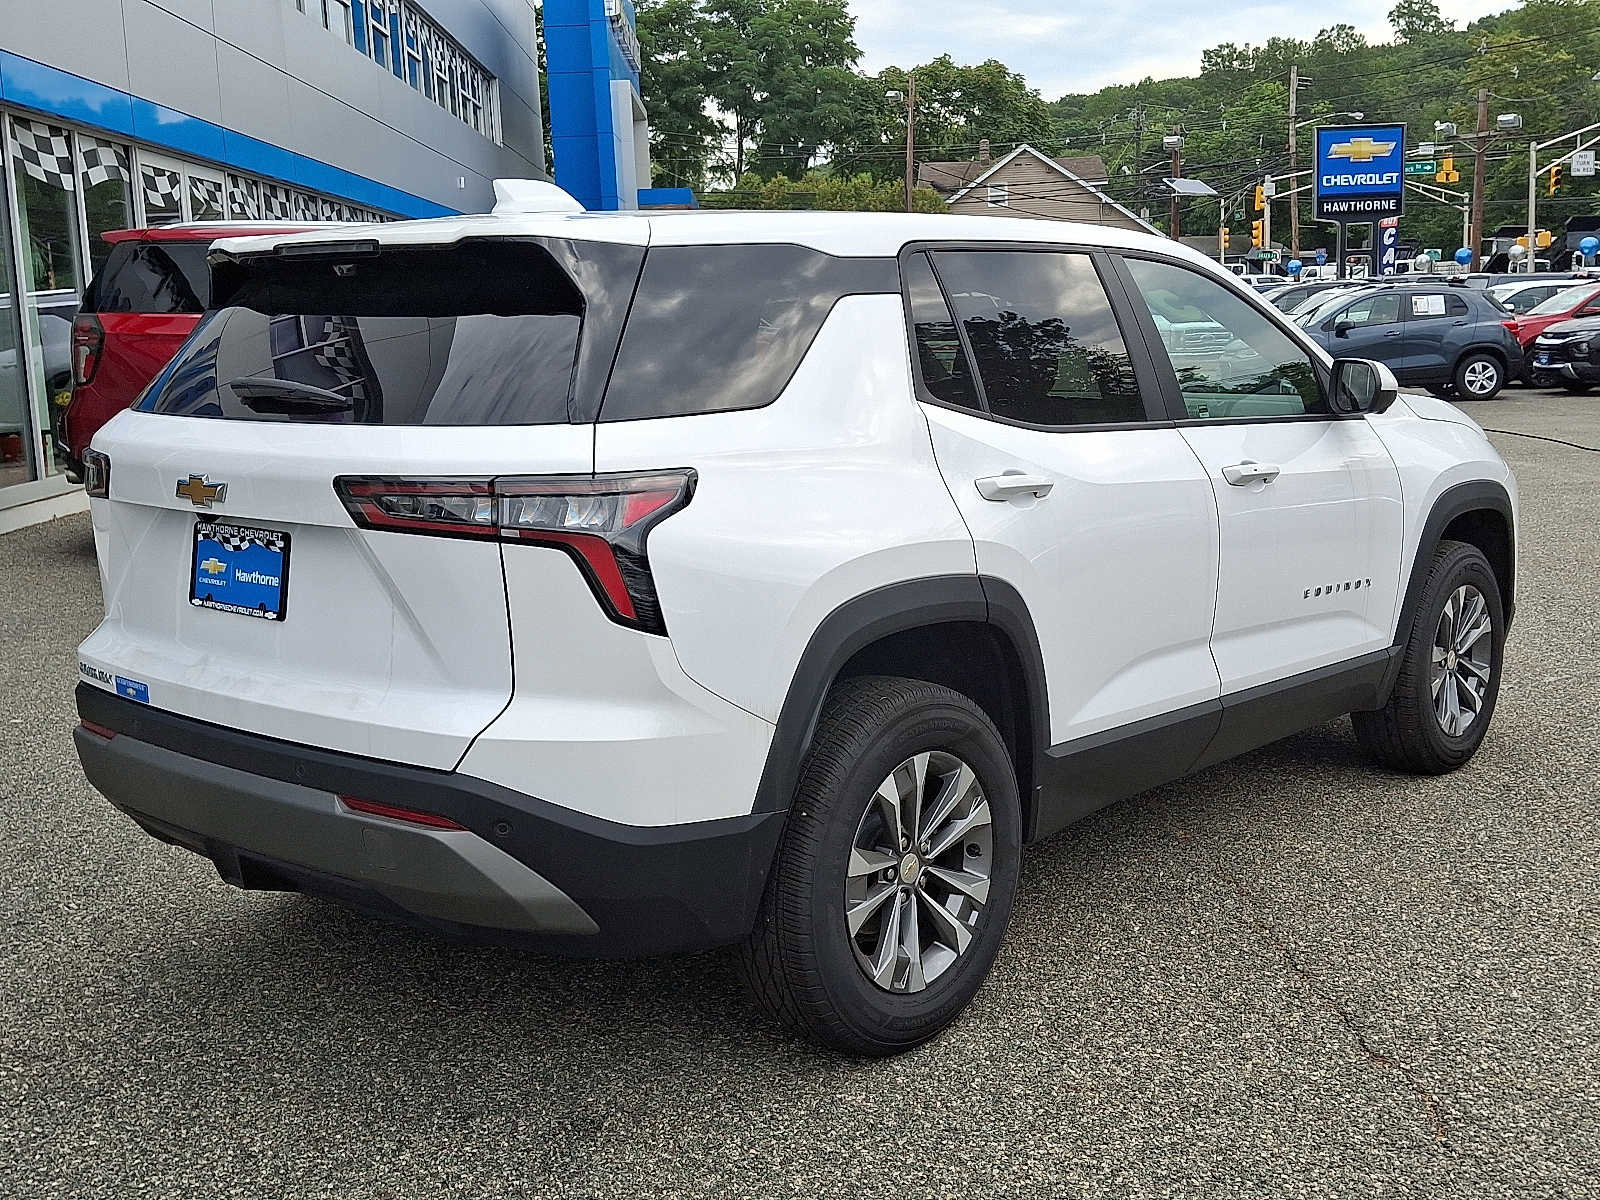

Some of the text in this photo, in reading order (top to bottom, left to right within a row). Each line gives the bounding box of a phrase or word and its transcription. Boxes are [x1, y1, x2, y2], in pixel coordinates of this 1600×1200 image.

[1322, 172, 1400, 187] CHEVROLET
[1323, 199, 1397, 213] HAWTHORNE
[197, 522, 282, 541] HAWTHORNE CHEVROLET
[198, 576, 227, 588] CHEVROLET
[235, 568, 280, 587] Hawthorne
[1303, 578, 1372, 600] EQUINOX
